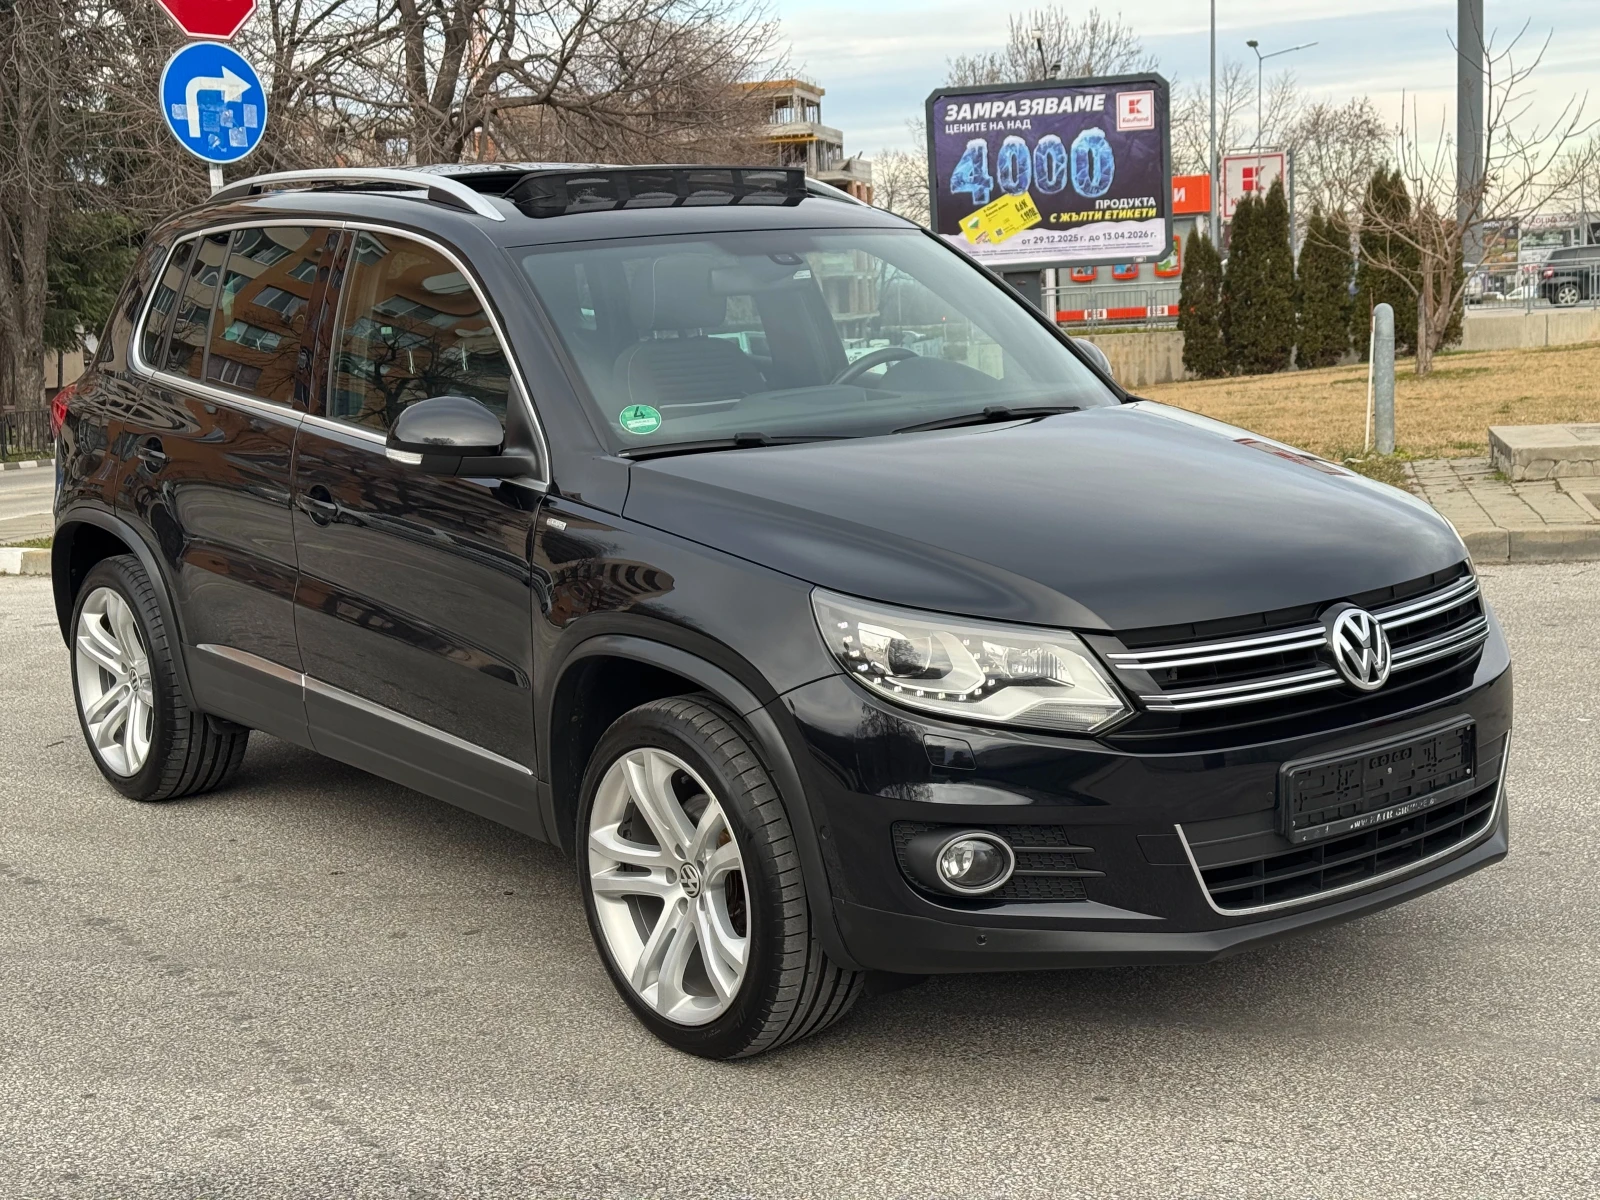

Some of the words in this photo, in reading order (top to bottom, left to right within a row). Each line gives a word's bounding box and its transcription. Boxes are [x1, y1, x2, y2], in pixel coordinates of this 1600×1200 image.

[945, 94, 1106, 121] ЗАМРАЗЯВАМЕ
[945, 122, 987, 135] ЦЕНИТЕ
[989, 121, 1005, 131] НА
[1006, 119, 1032, 130] НАД
[950, 127, 1115, 205] 4000
[1095, 197, 1156, 209] ПРОДУКТА
[1050, 213, 1057, 223] С
[1059, 210, 1102, 222] ЖЪЛТИ
[1104, 207, 1157, 220] ЕТИКЕТИ
[1033, 234, 1078, 245] 29.12.2025
[1103, 230, 1149, 241] 13.04.2026
